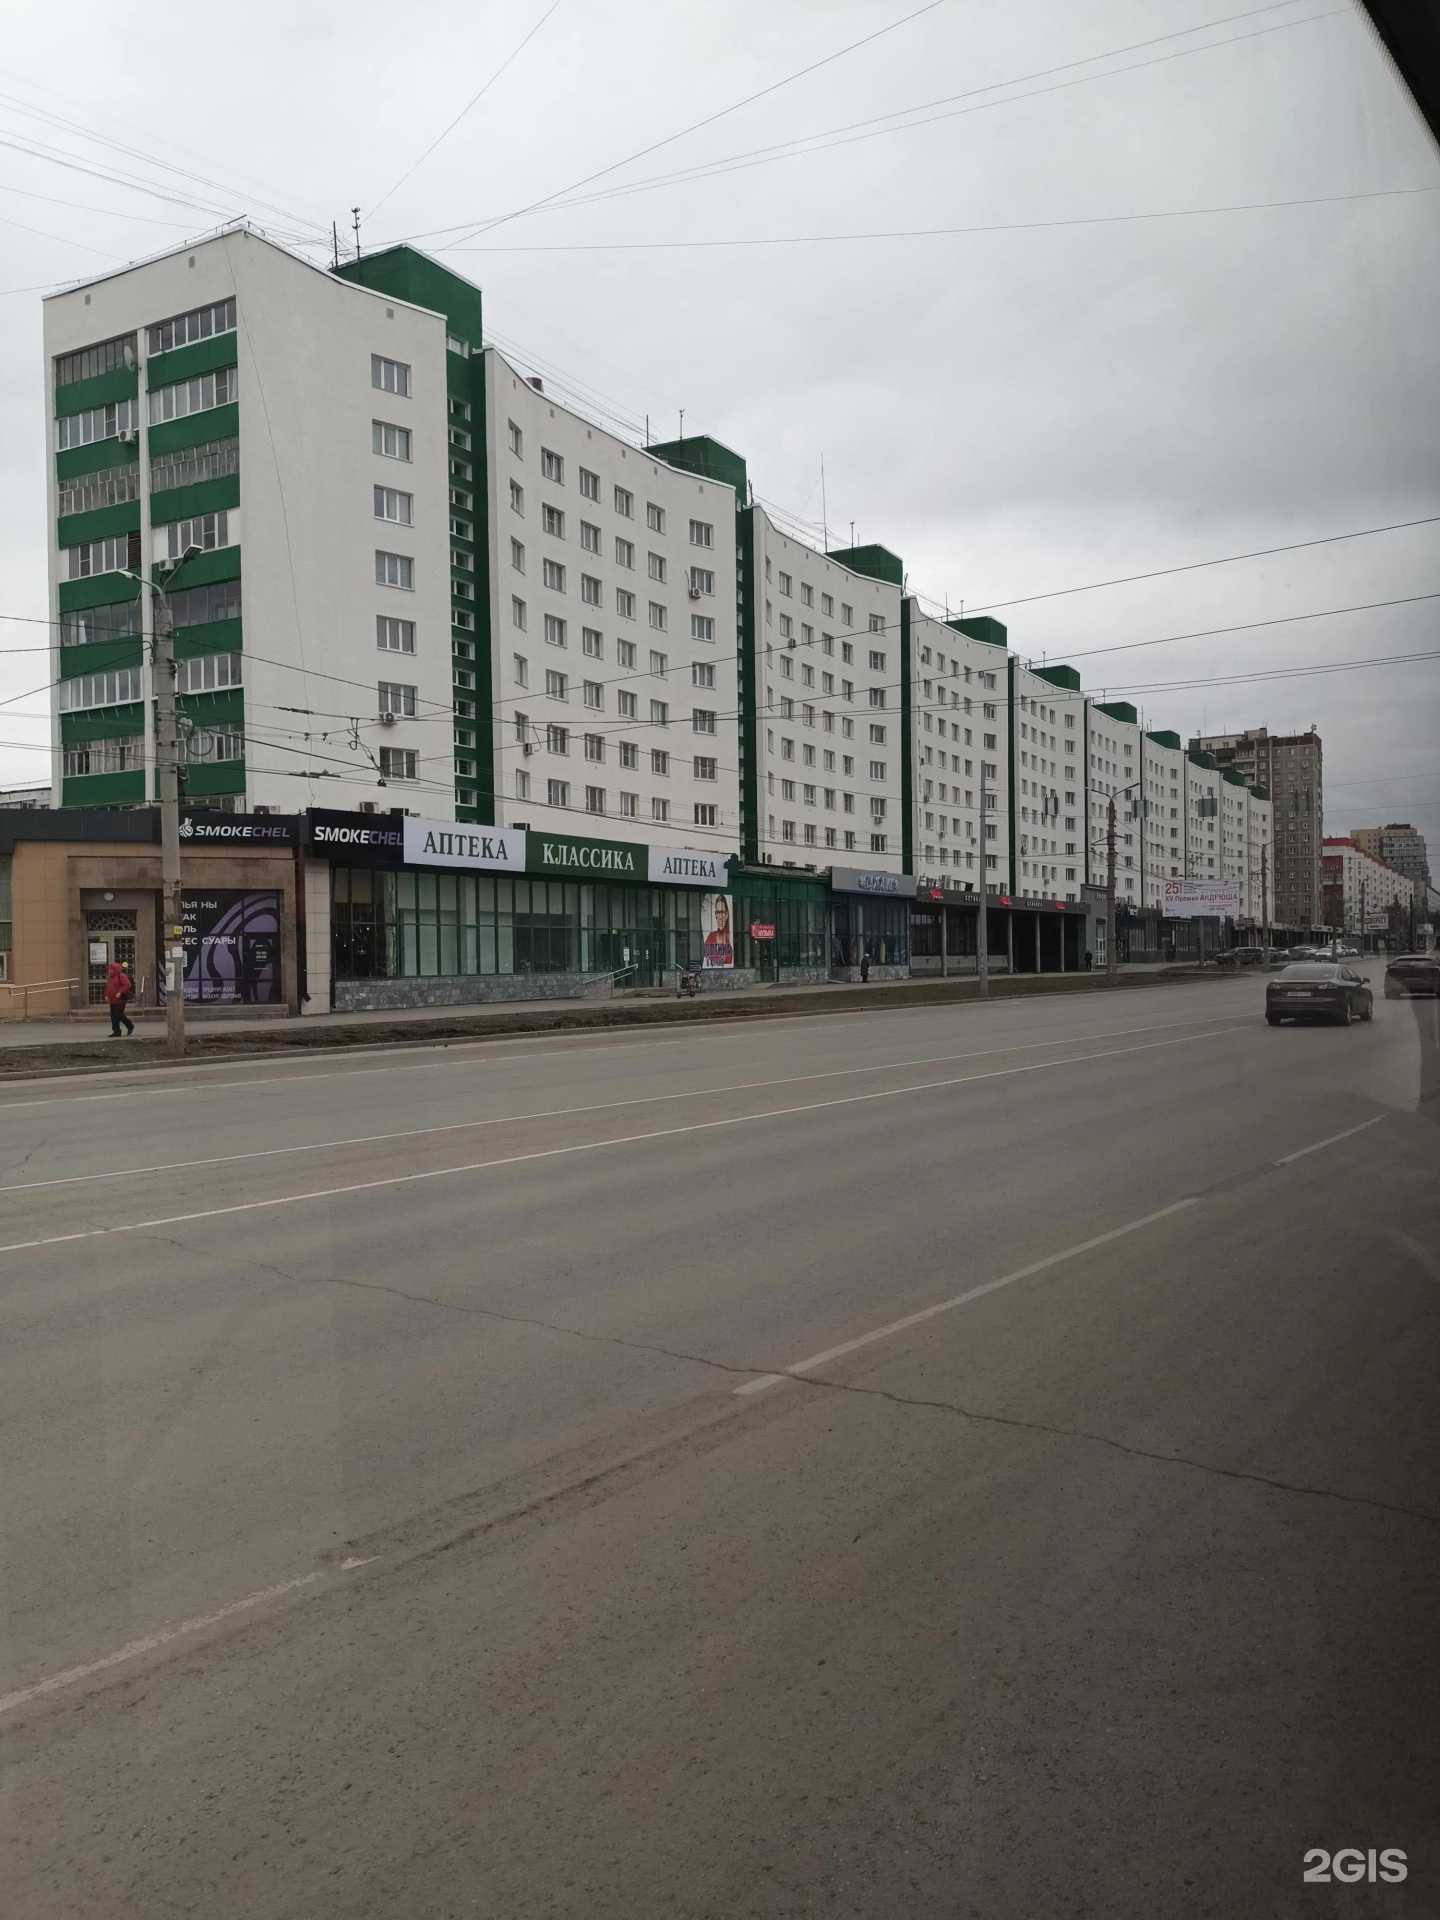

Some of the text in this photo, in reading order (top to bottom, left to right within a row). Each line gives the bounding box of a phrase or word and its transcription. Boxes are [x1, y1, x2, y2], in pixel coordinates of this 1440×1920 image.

[194, 825, 291, 838] SMOKECHEL
[313, 826, 404, 846] SMOKECHEL
[422, 830, 509, 860] АПТЕКА
[542, 843, 635, 871] КЛАССИКА
[663, 856, 717, 878] АПТЕКА
